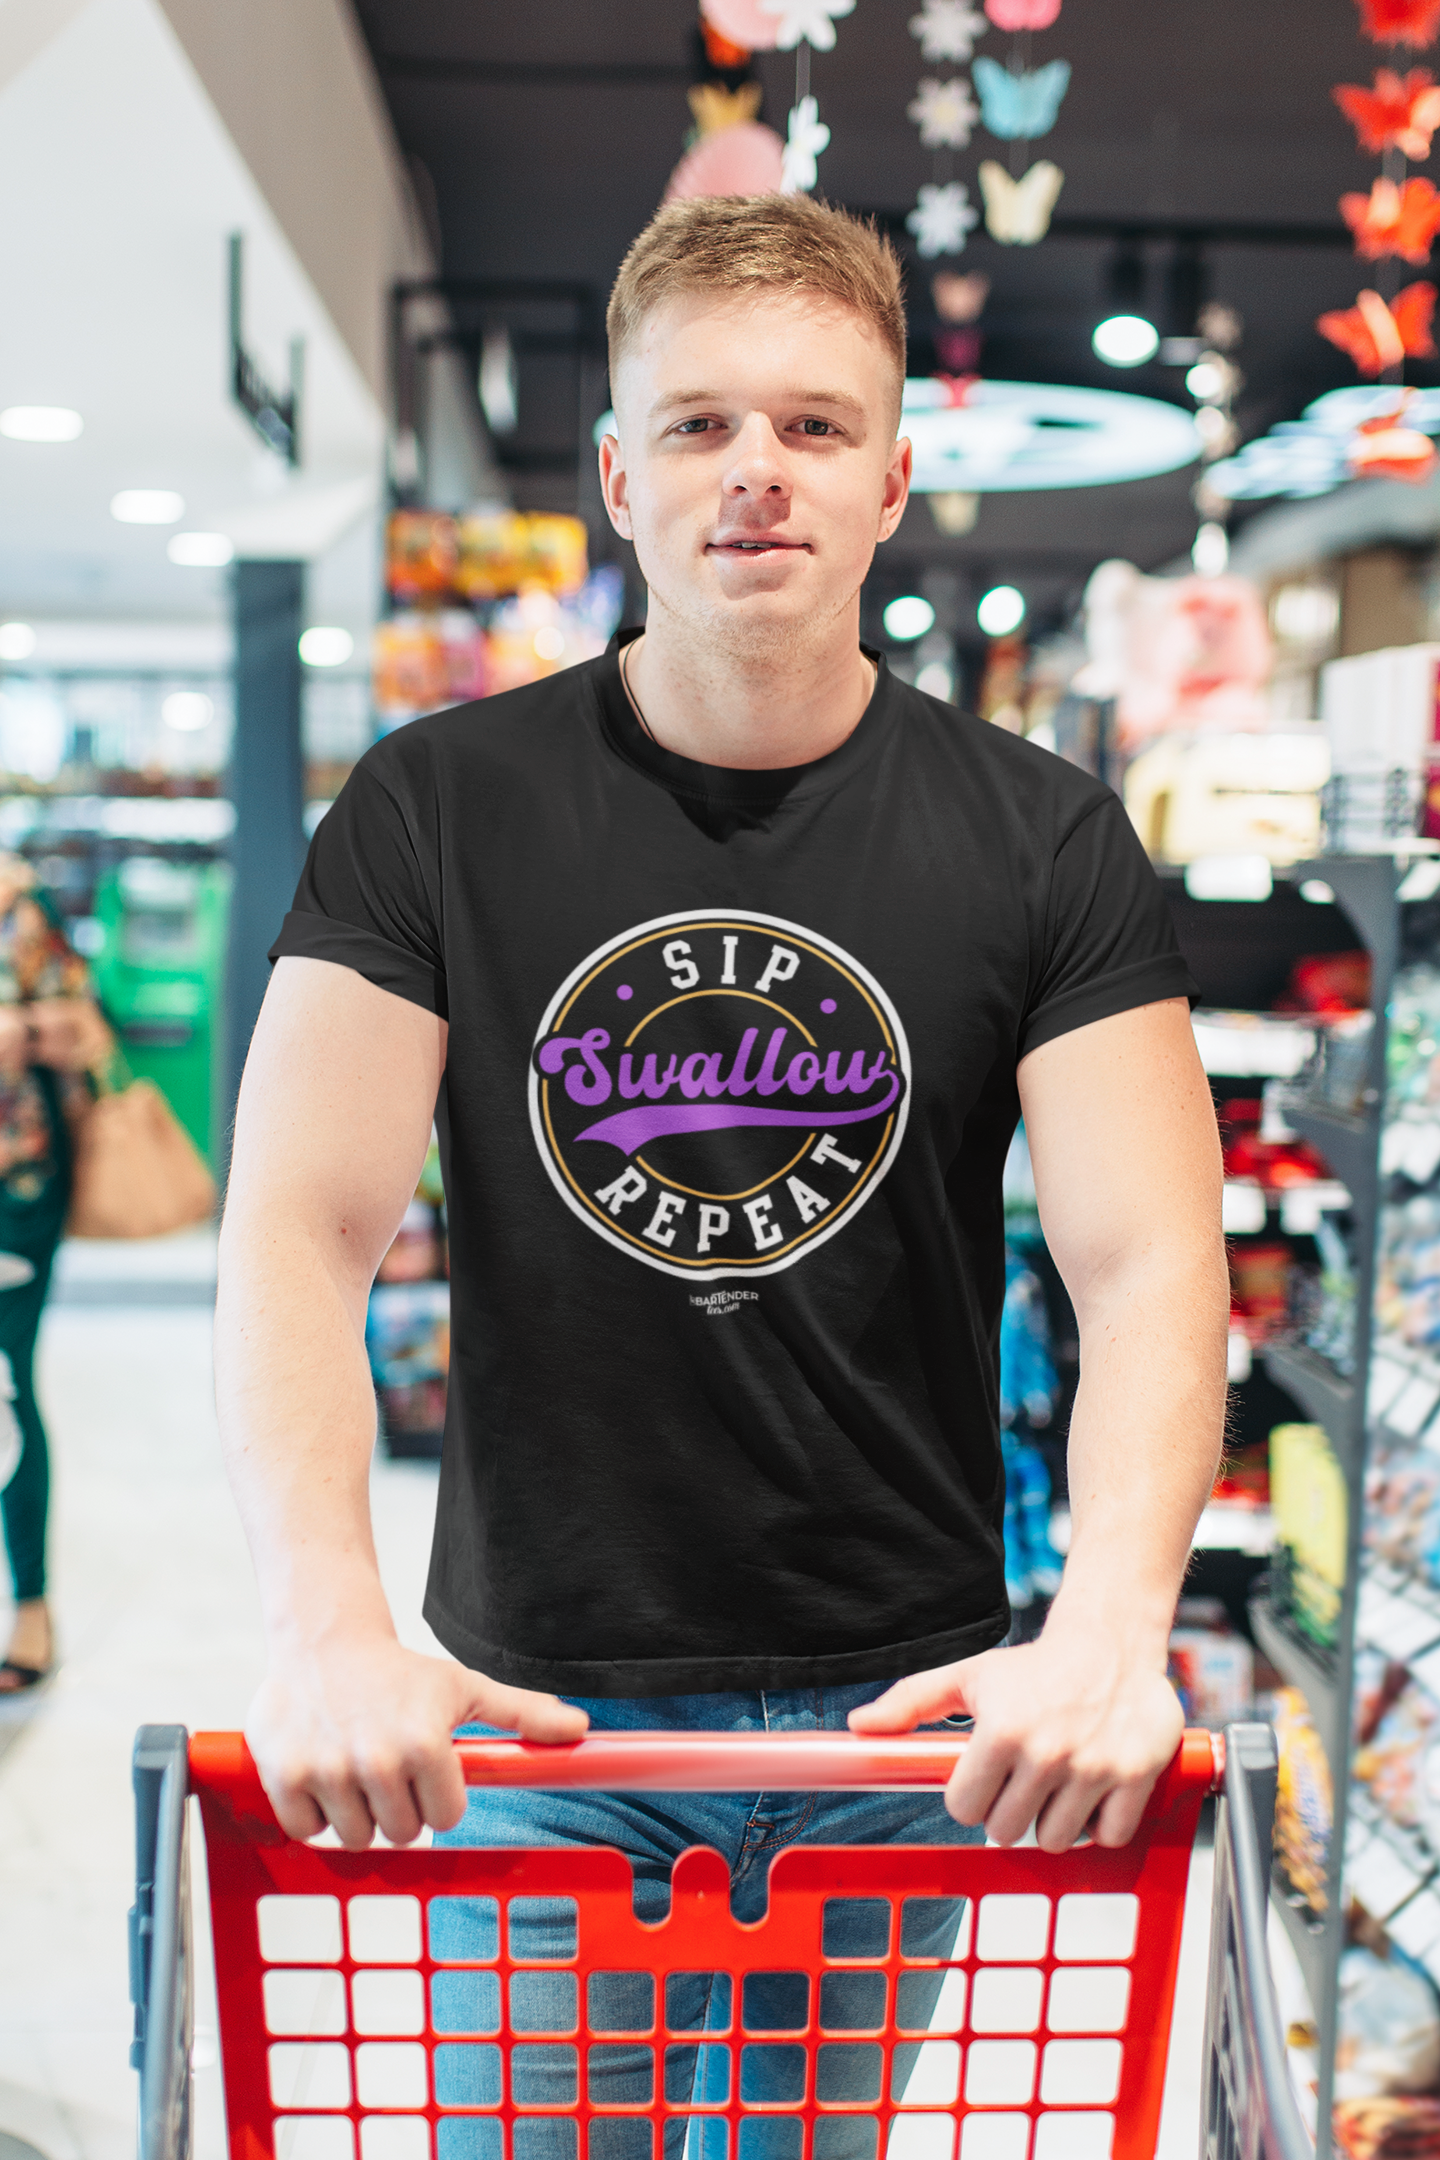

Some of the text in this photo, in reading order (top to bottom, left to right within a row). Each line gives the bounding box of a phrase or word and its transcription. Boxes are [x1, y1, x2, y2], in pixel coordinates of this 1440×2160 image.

[662, 935, 800, 993] SIP
[539, 1027, 892, 1106] Swallow
[594, 1133, 862, 1252] REPEAT
[696, 1290, 759, 1306] BARTENDER
